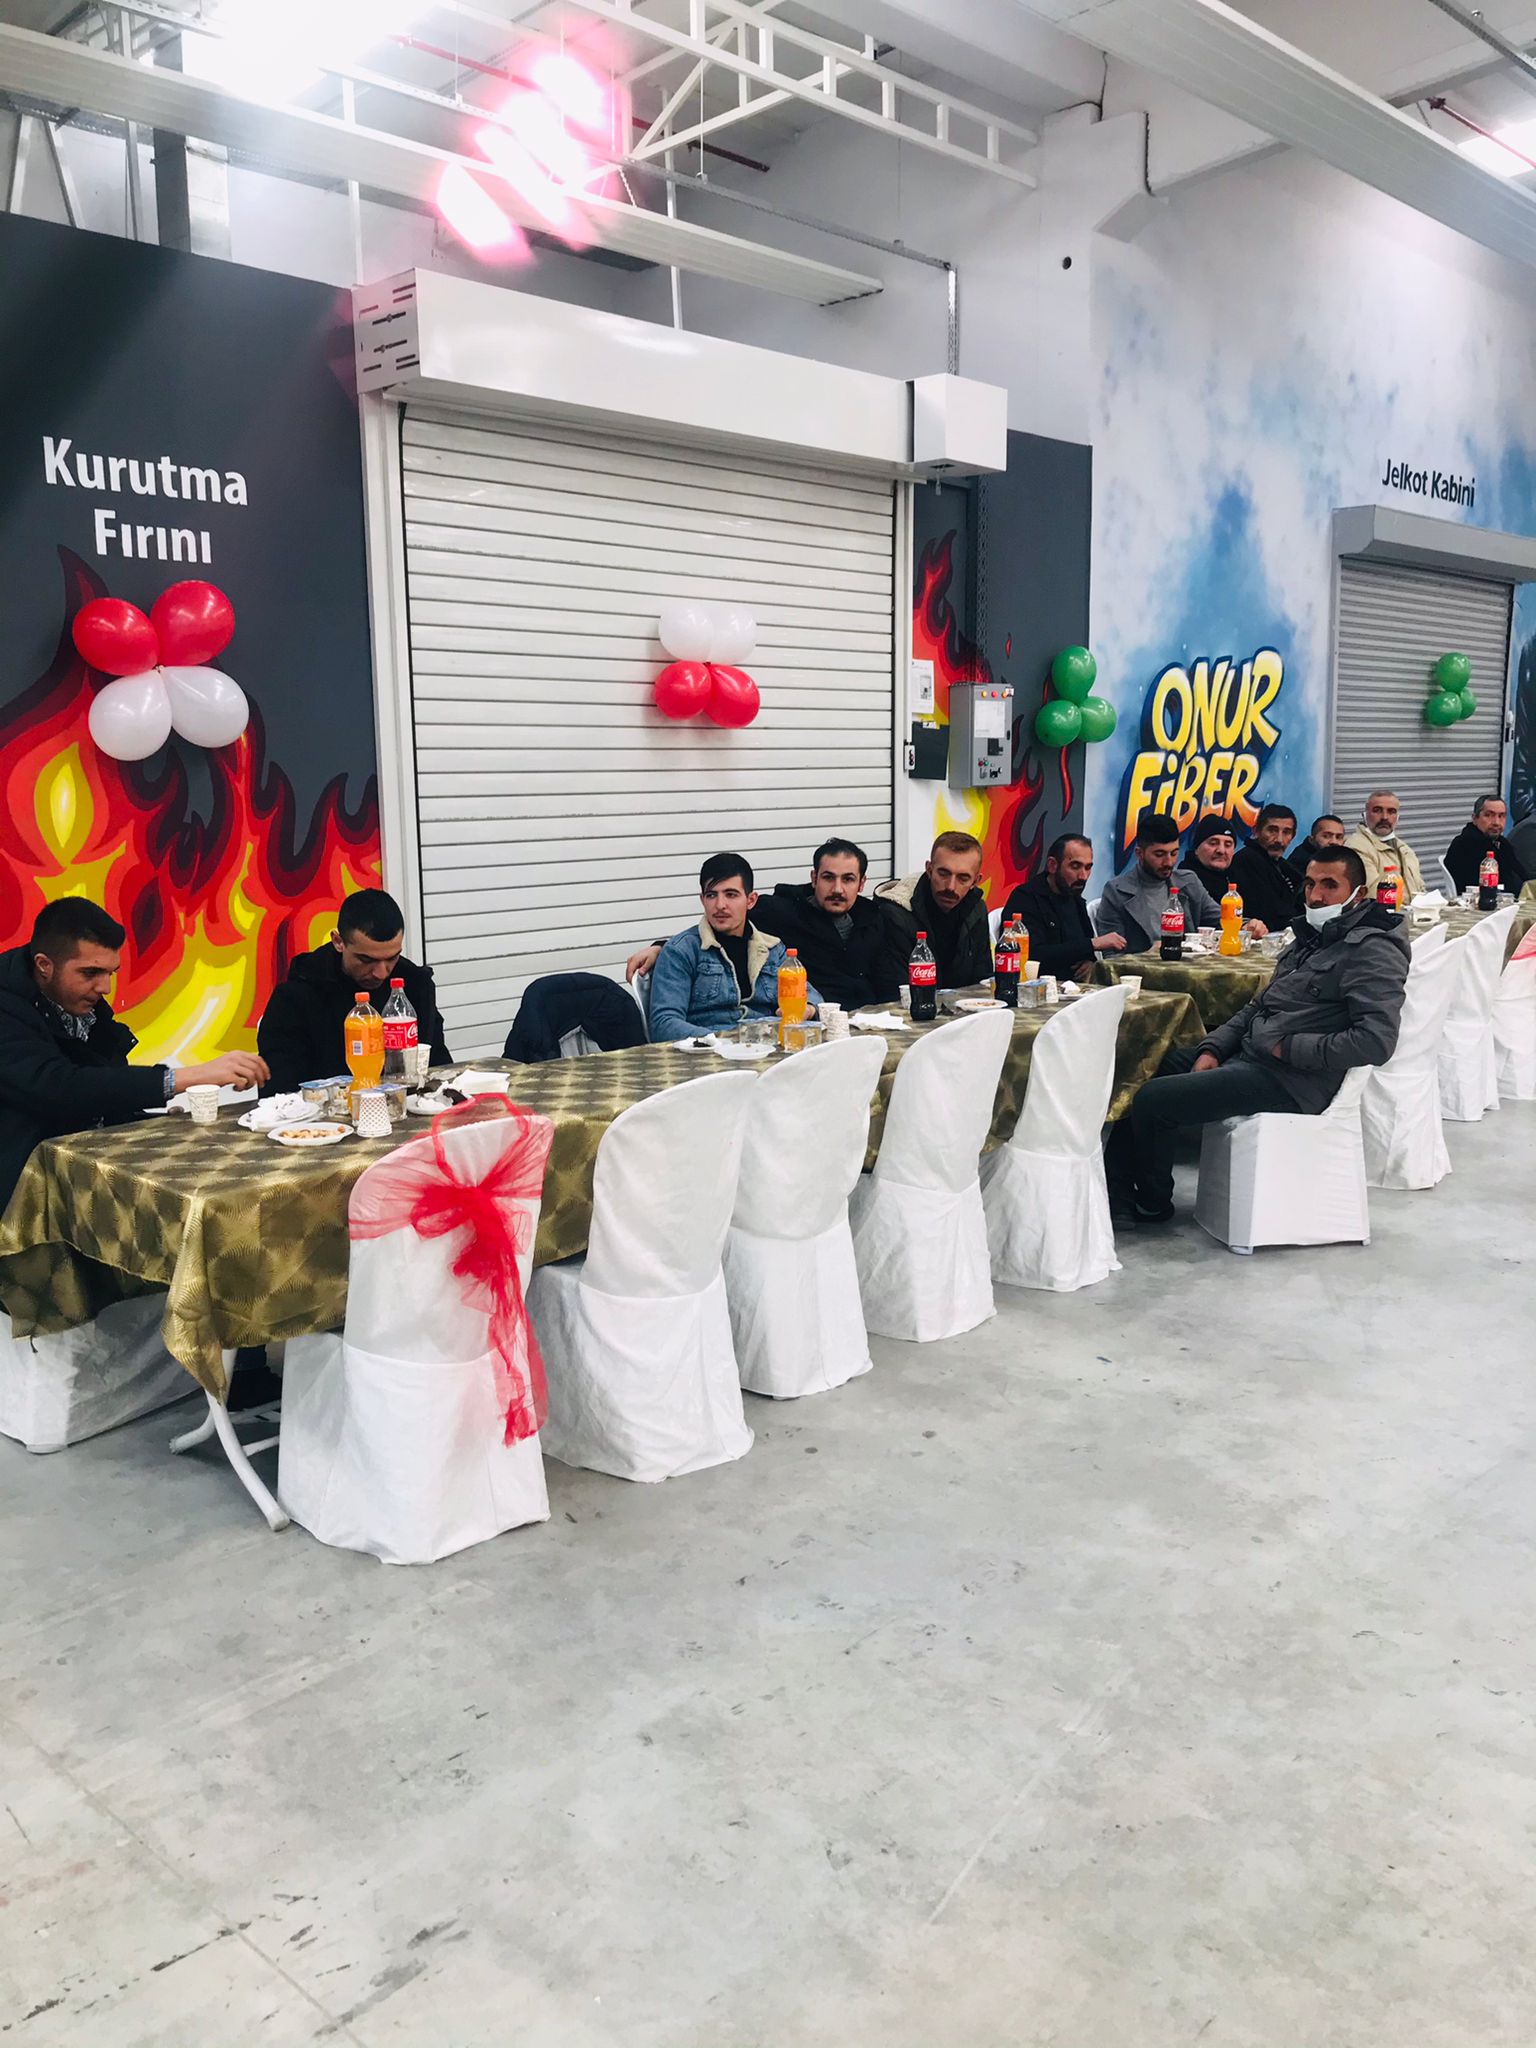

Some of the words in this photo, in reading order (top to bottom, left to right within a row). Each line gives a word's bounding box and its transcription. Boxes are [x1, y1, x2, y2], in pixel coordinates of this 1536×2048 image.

[43, 436, 248, 506] Kurutma
[1382, 458, 1428, 496] Jelkot
[1430, 470, 1475, 508] Kabini
[94, 508, 212, 564] Fırını
[1146, 648, 1284, 762] ONUR
